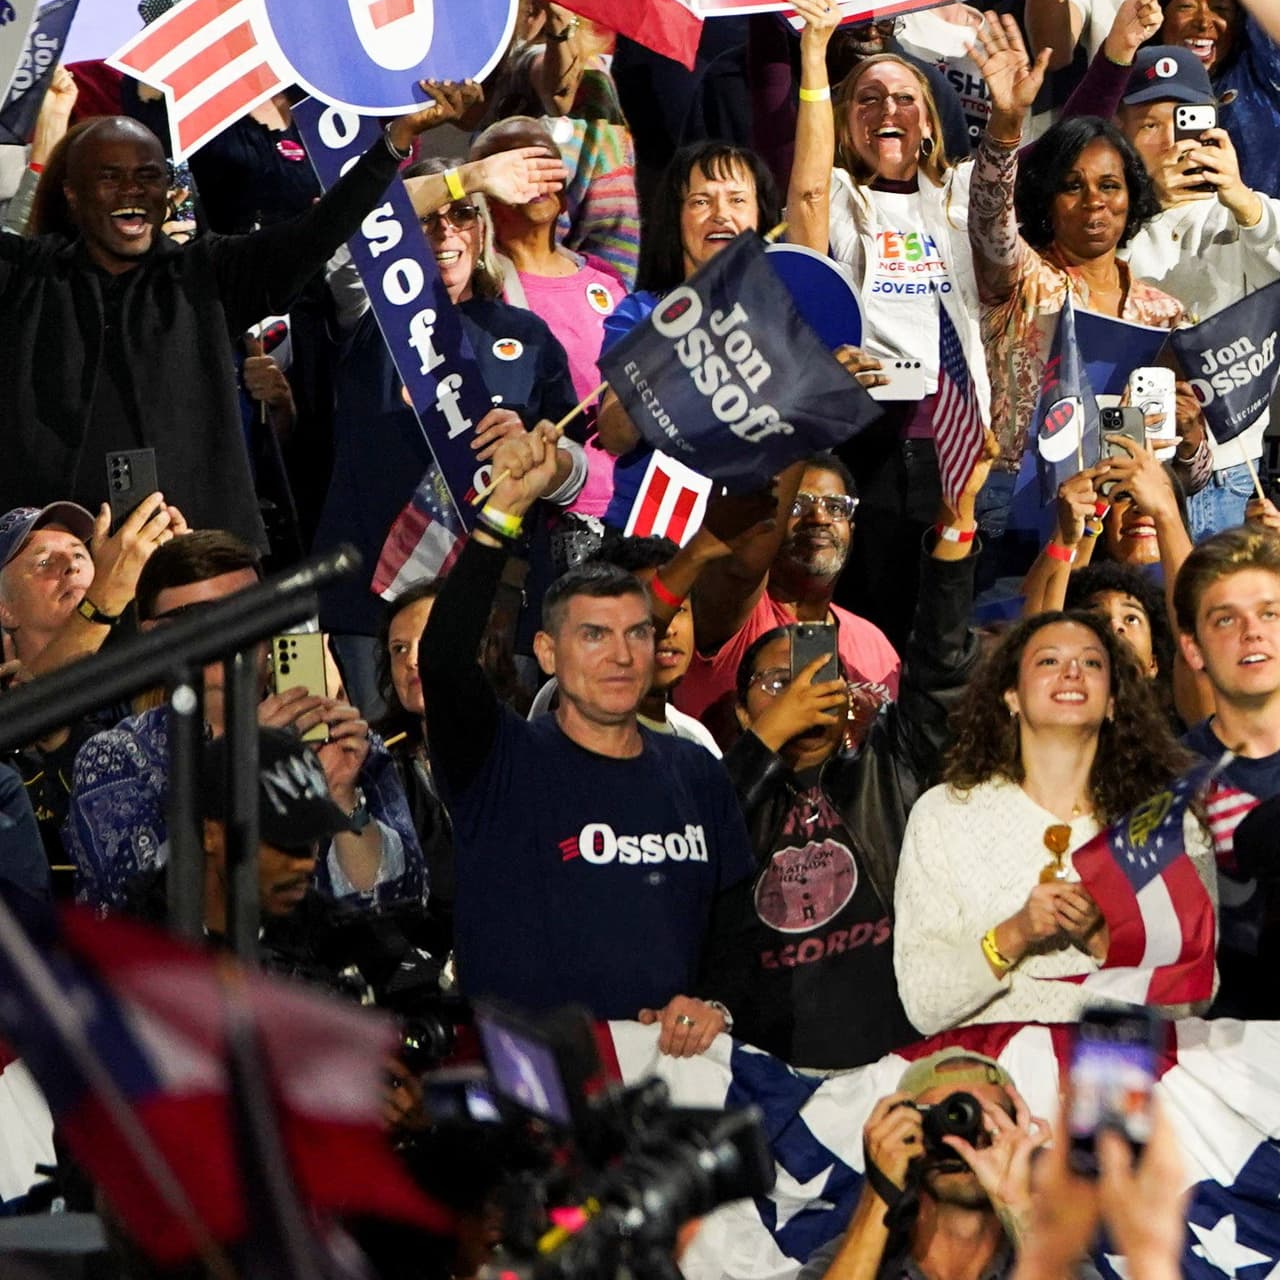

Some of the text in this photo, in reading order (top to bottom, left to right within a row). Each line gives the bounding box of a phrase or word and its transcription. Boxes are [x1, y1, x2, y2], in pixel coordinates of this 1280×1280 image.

[652, 286, 795, 442] Ossoff
[710, 302, 772, 395] Jon
[1200, 337, 1256, 375] Jon
[578, 822, 709, 865] Ossoff
